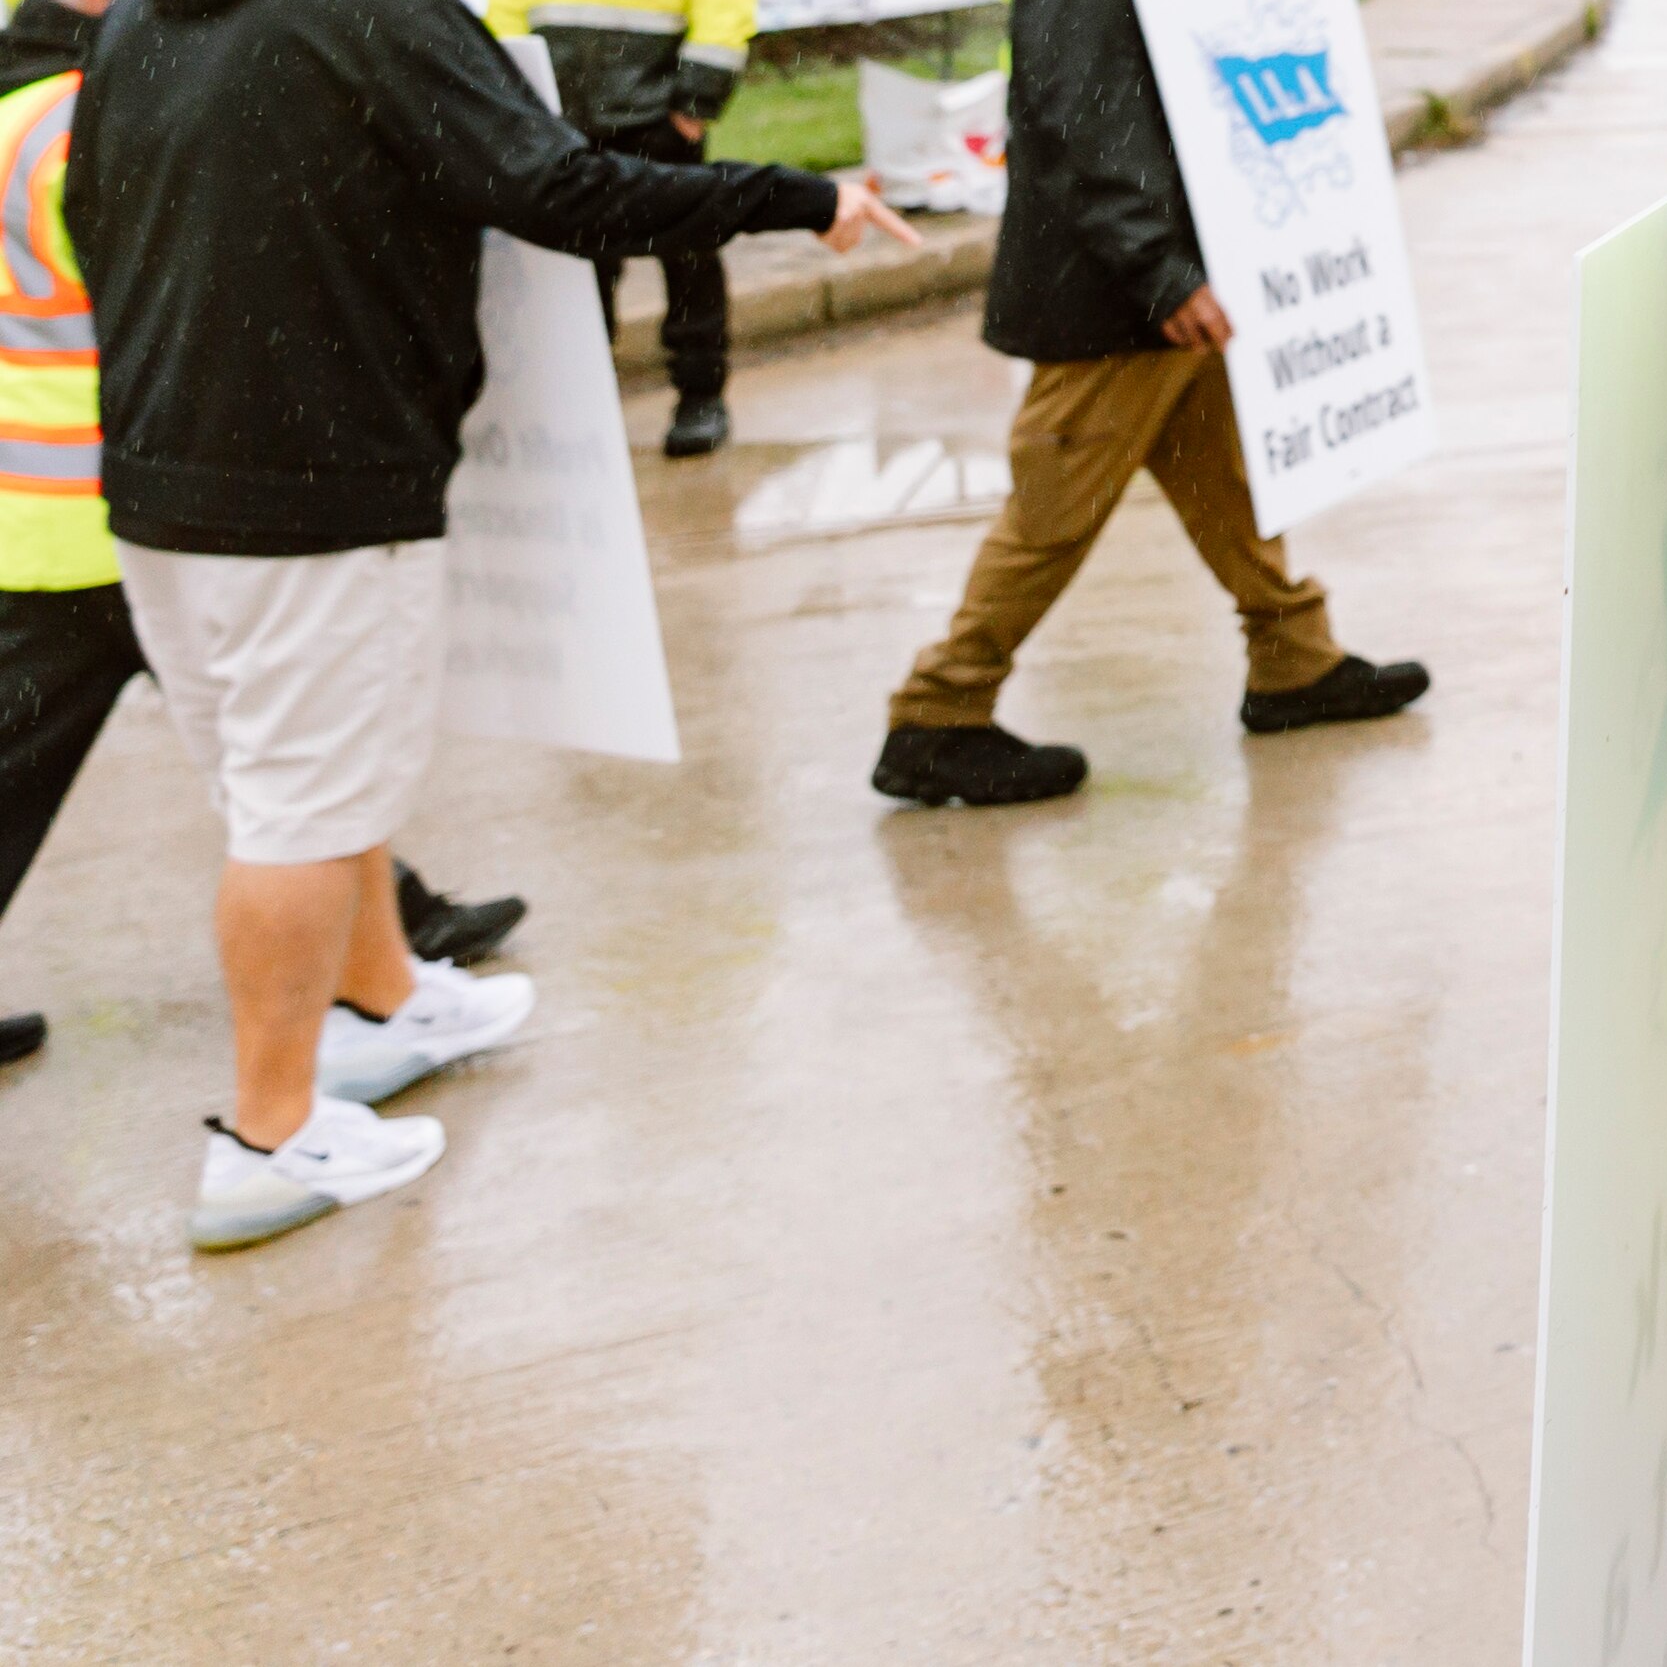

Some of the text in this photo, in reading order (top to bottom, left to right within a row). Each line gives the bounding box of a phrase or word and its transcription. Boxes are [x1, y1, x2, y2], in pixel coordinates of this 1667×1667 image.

[1260, 237, 1373, 312] No Work
[1266, 315, 1371, 392] Without
[1262, 374, 1419, 475] Fair Contract
